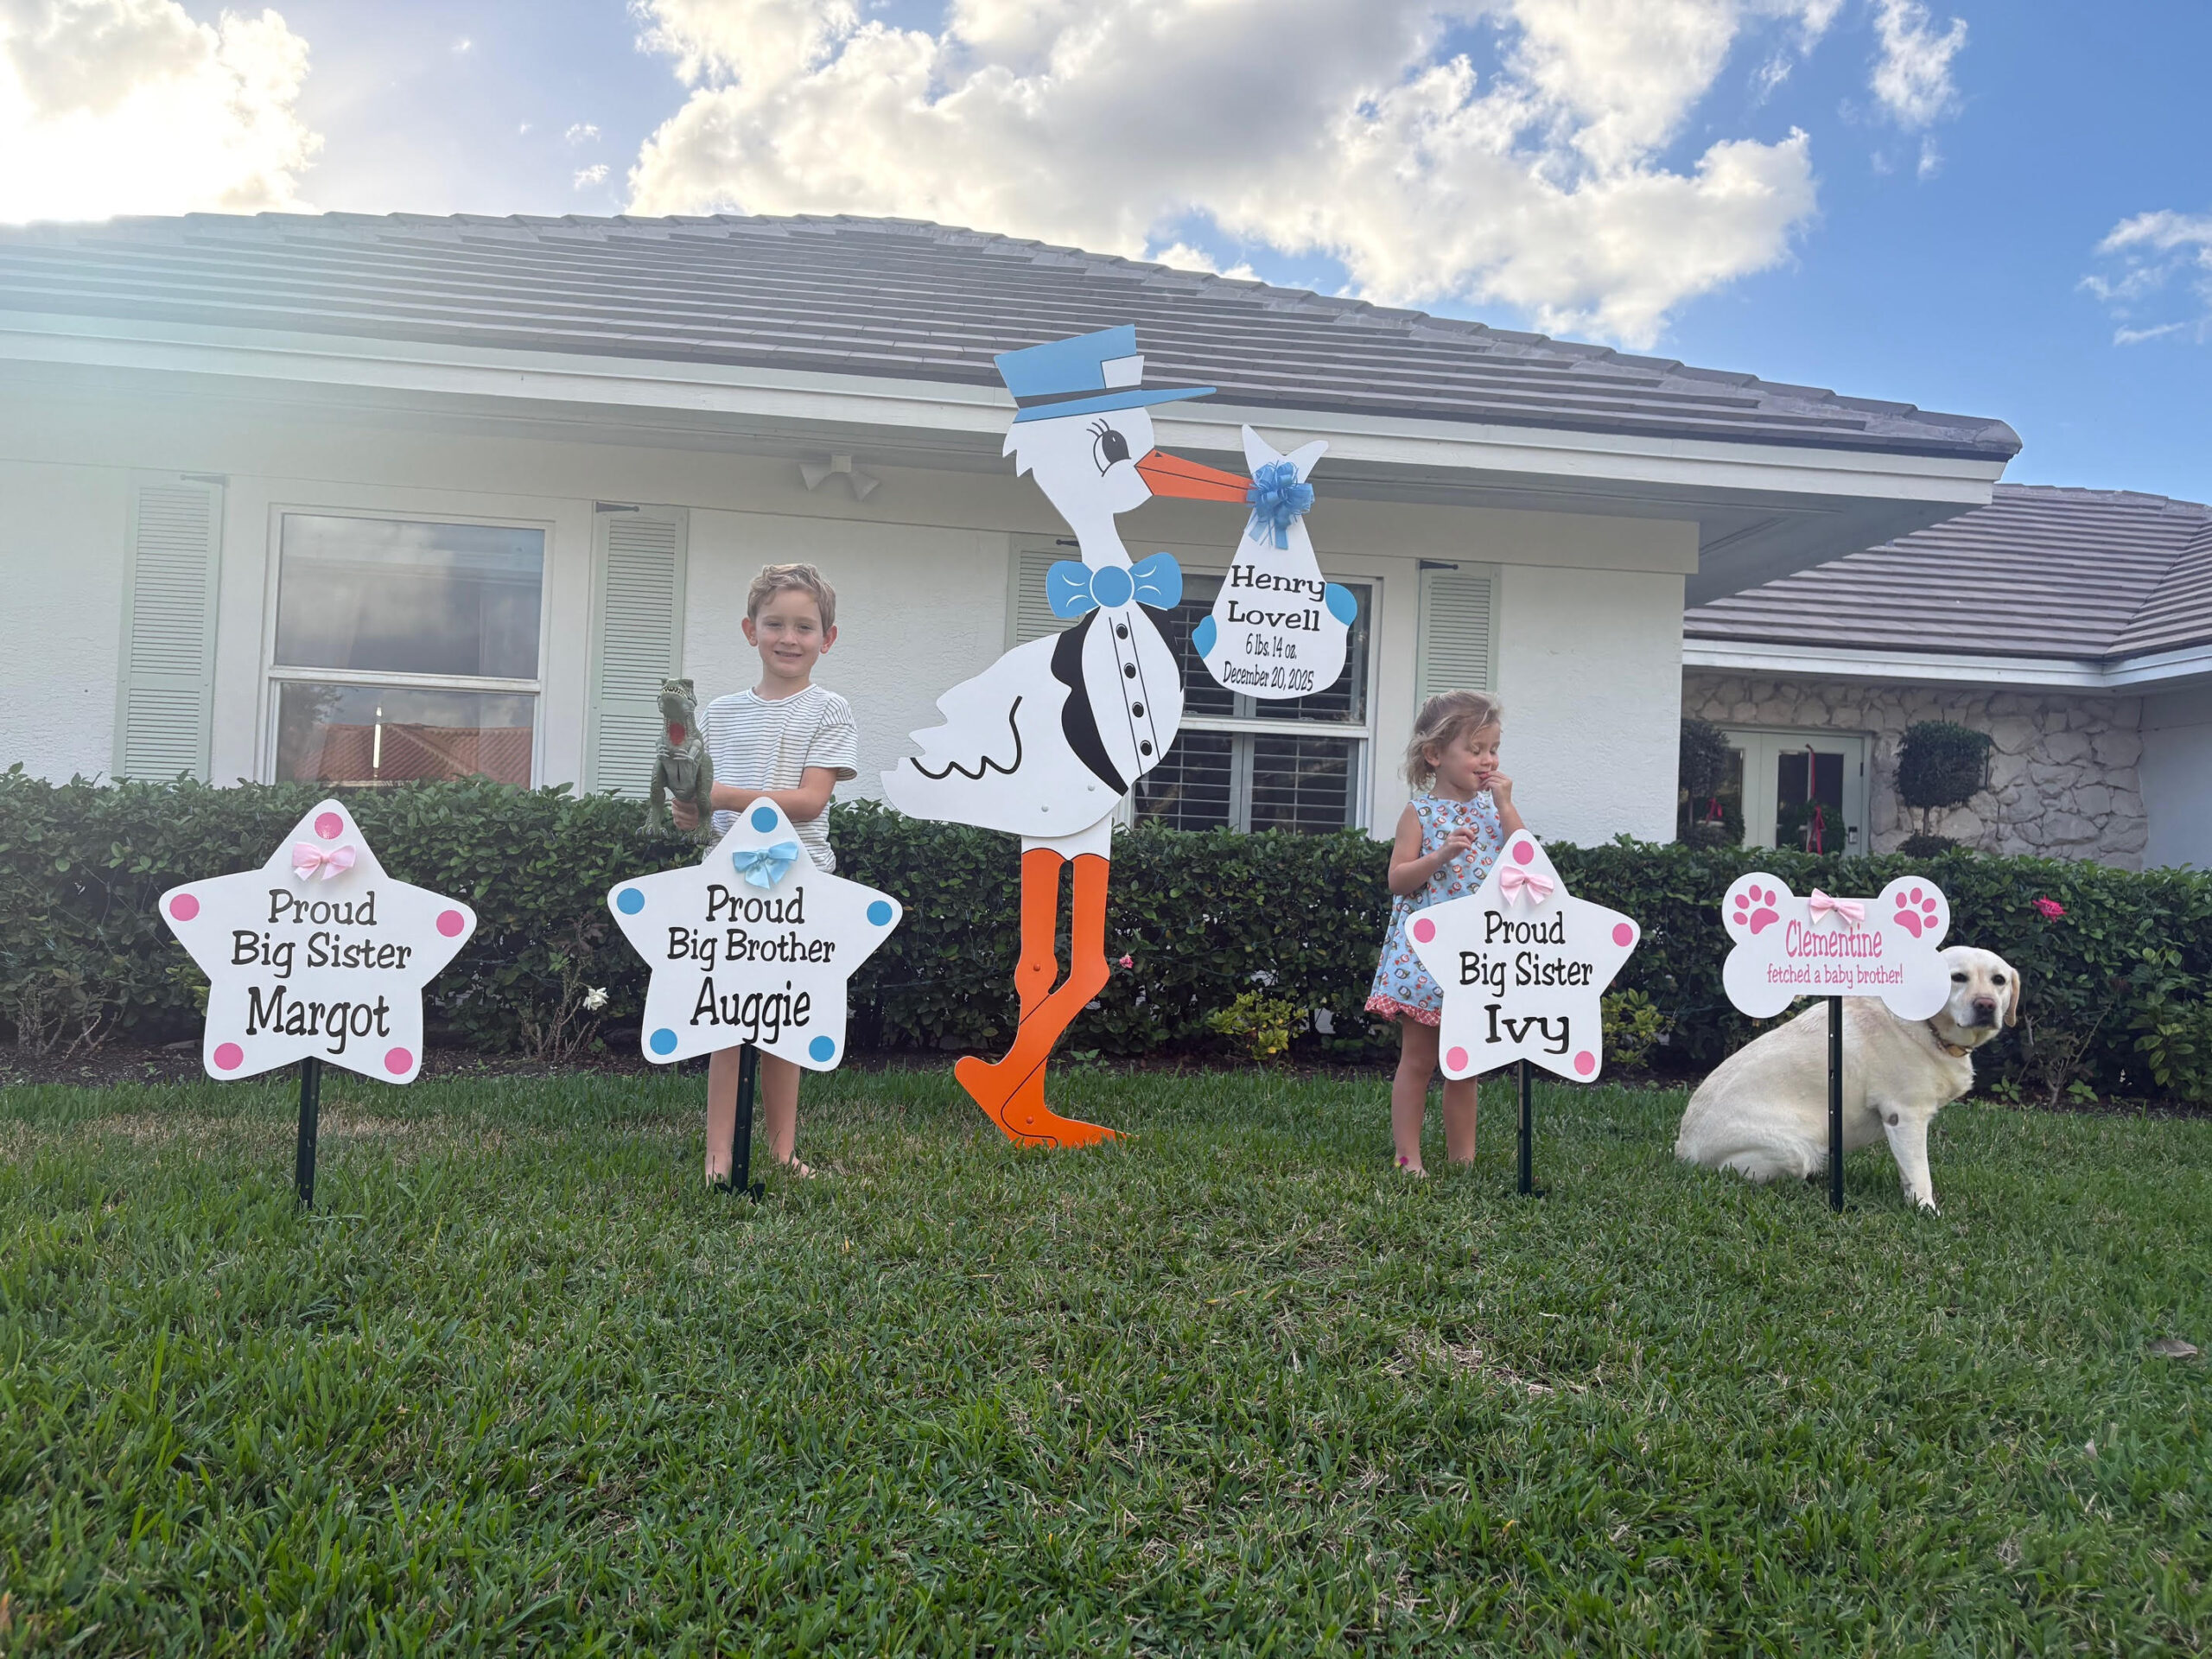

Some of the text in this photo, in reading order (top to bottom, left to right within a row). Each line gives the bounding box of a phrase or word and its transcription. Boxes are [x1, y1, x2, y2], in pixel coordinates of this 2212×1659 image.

[1230, 564, 1325, 602] Henry
[1228, 601, 1320, 632] Lovell
[1245, 632, 1254, 654] 6
[1255, 633, 1269, 657] lbs.
[1273, 635, 1283, 658] 14
[1223, 660, 1314, 691] December 20, 2025
[267, 888, 378, 926] Proud
[705, 884, 805, 925] Proud
[1484, 911, 1566, 944] Proud
[1785, 918, 1883, 958] Clementine
[231, 930, 412, 979] Big Sister
[667, 926, 836, 972] Big Brother
[1459, 950, 1593, 998] Big Sister
[1767, 963, 1904, 989] fetched a baby brother!
[245, 984, 391, 1055] Margot
[690, 976, 811, 1045] Auggie
[1484, 1003, 1570, 1055] Ivy
